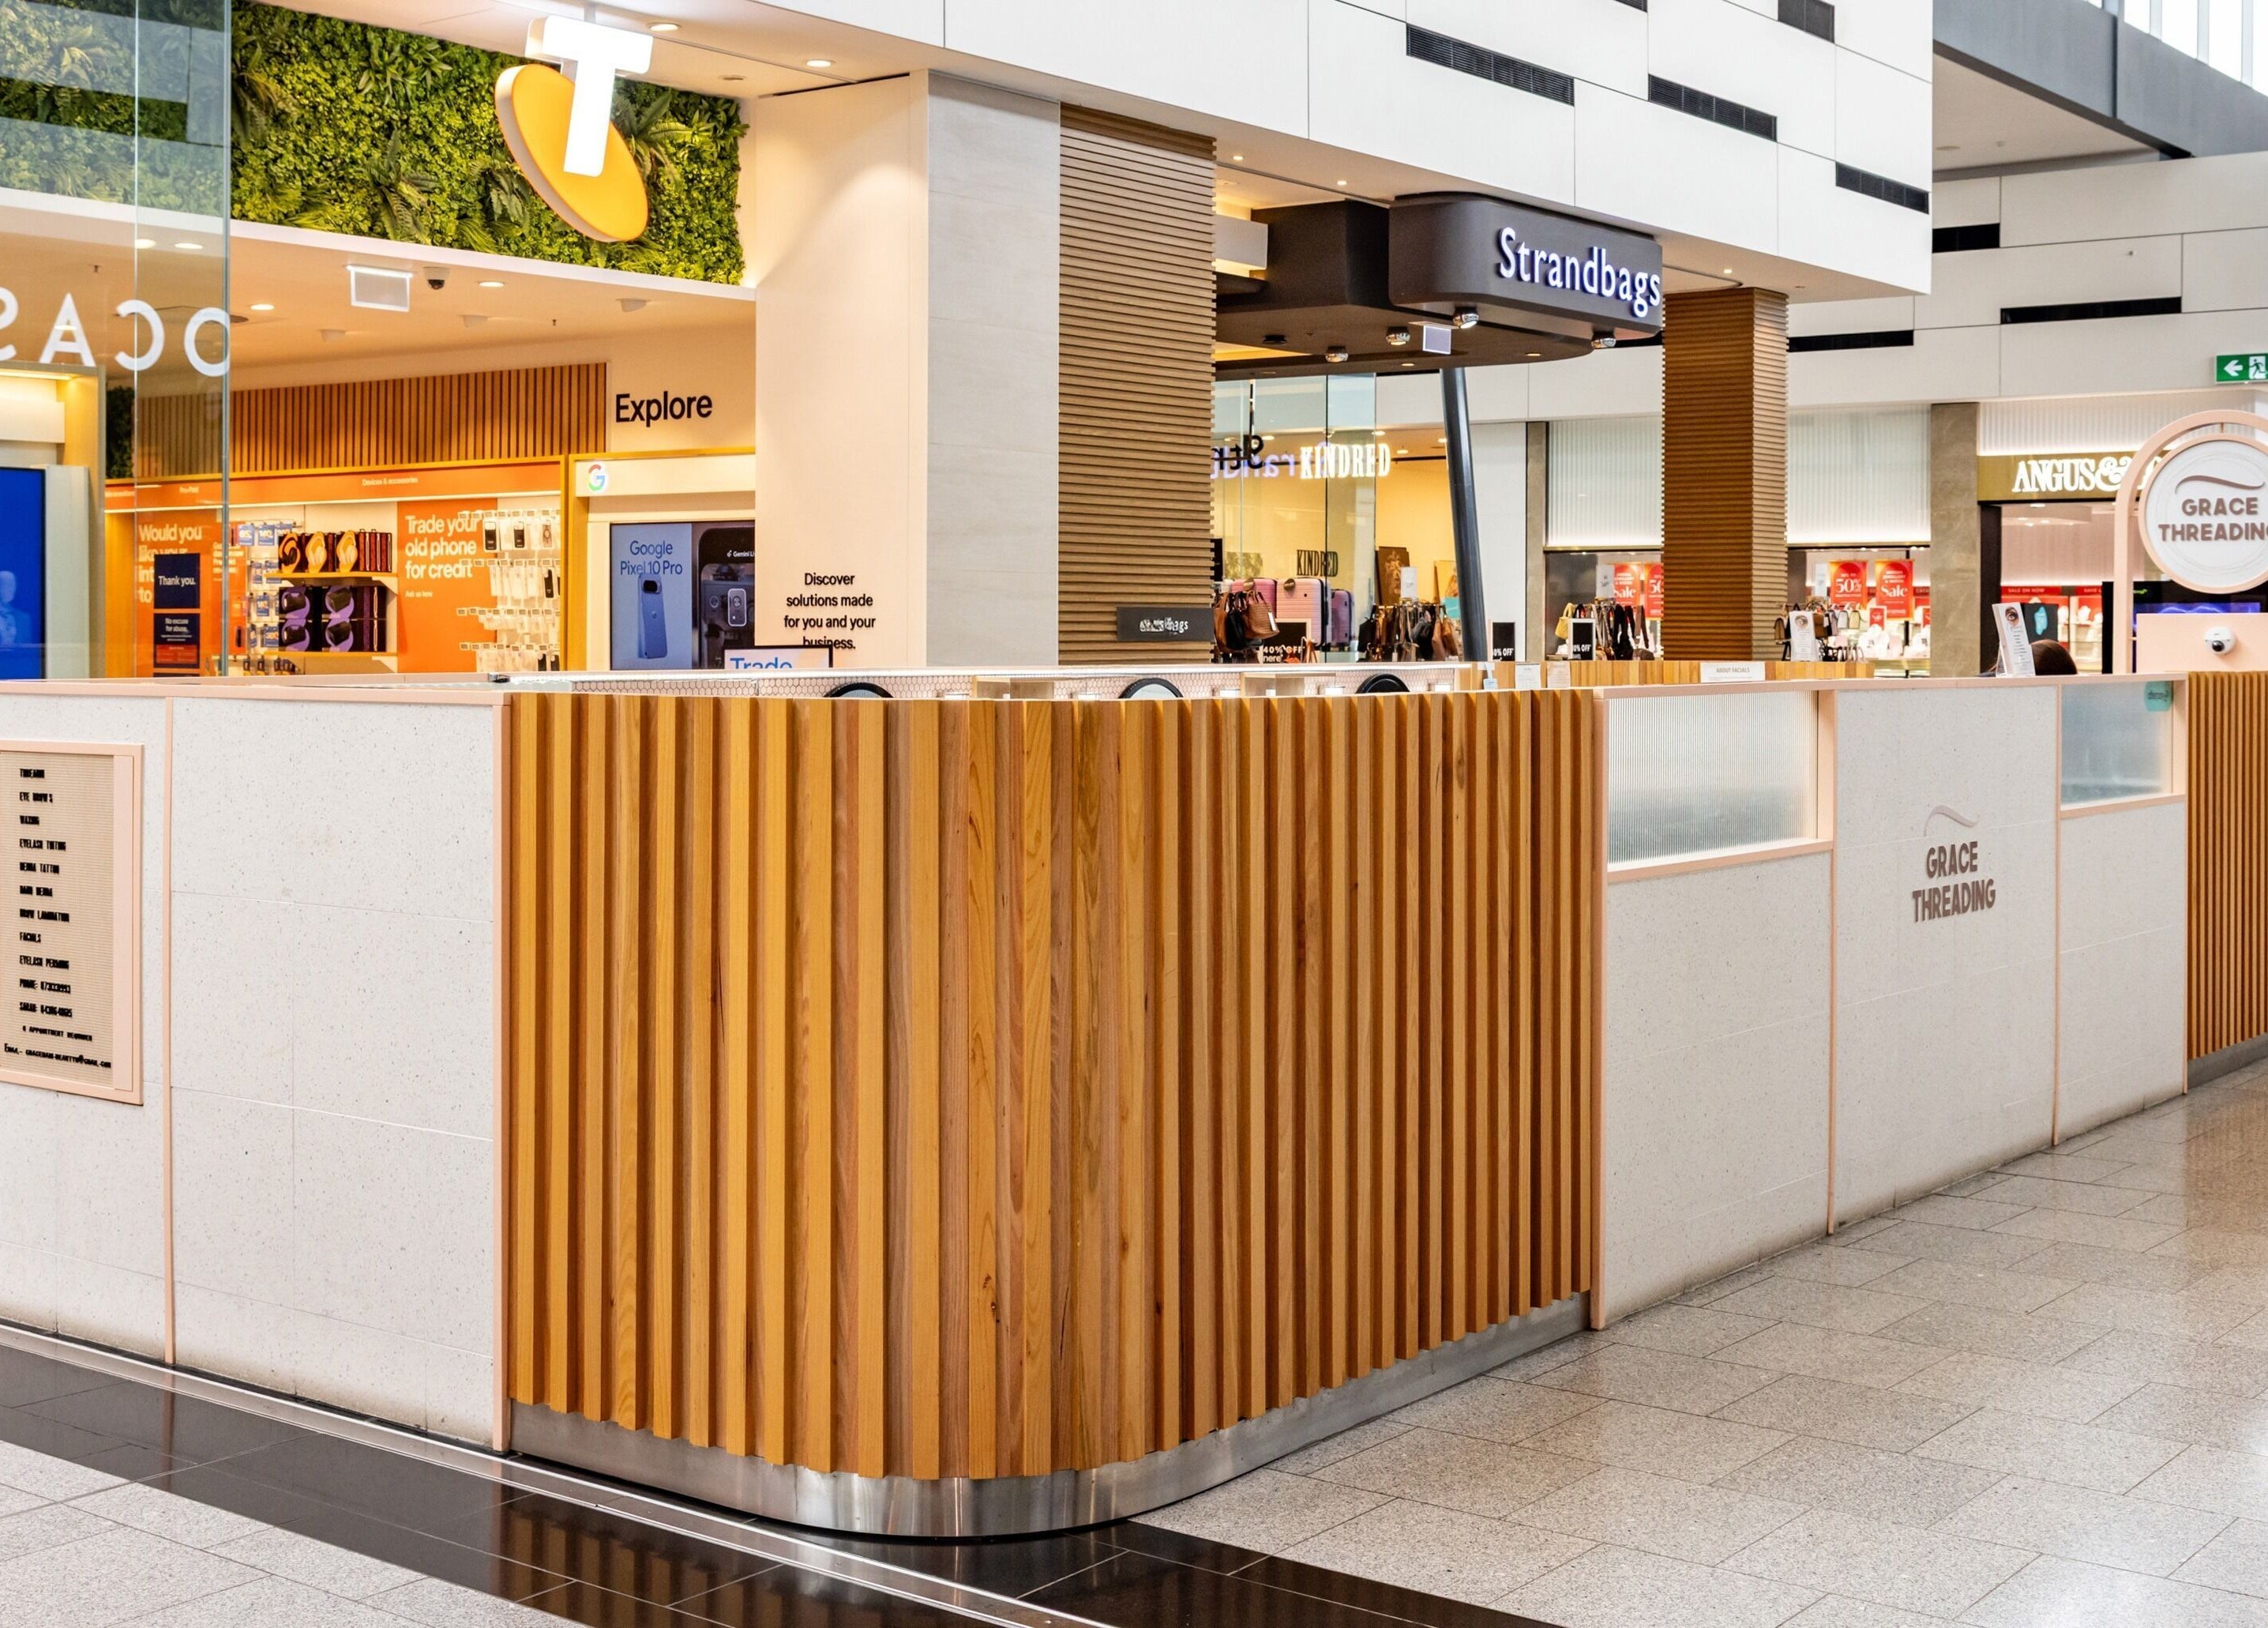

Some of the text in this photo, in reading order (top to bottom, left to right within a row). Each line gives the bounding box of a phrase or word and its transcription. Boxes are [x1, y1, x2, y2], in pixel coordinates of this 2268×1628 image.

[1496, 226, 1662, 318] Strandbags
[616, 391, 712, 427] Explore
[1300, 442, 1391, 479] KINDRED
[2181, 497, 2259, 517] GRACE
[138, 523, 202, 544] Would you
[404, 515, 479, 537] Trade your
[405, 538, 477, 560] old phone
[629, 540, 673, 562] Google
[405, 561, 474, 580] for credit
[620, 560, 683, 576] Pixel 10 Pro
[1297, 550, 1339, 577] KINDRED
[159, 575, 196, 587] Thank you.
[804, 572, 855, 586] Discover
[138, 587, 153, 603] to
[786, 593, 873, 607] solutions made
[1880, 585, 1909, 598] Sale
[783, 615, 877, 630] for you and your
[19, 838, 43, 849] EYELASH
[1926, 840, 1978, 879] GRACE
[1912, 878, 1996, 923] THREADING
[19, 955, 43, 966] EYELASH
